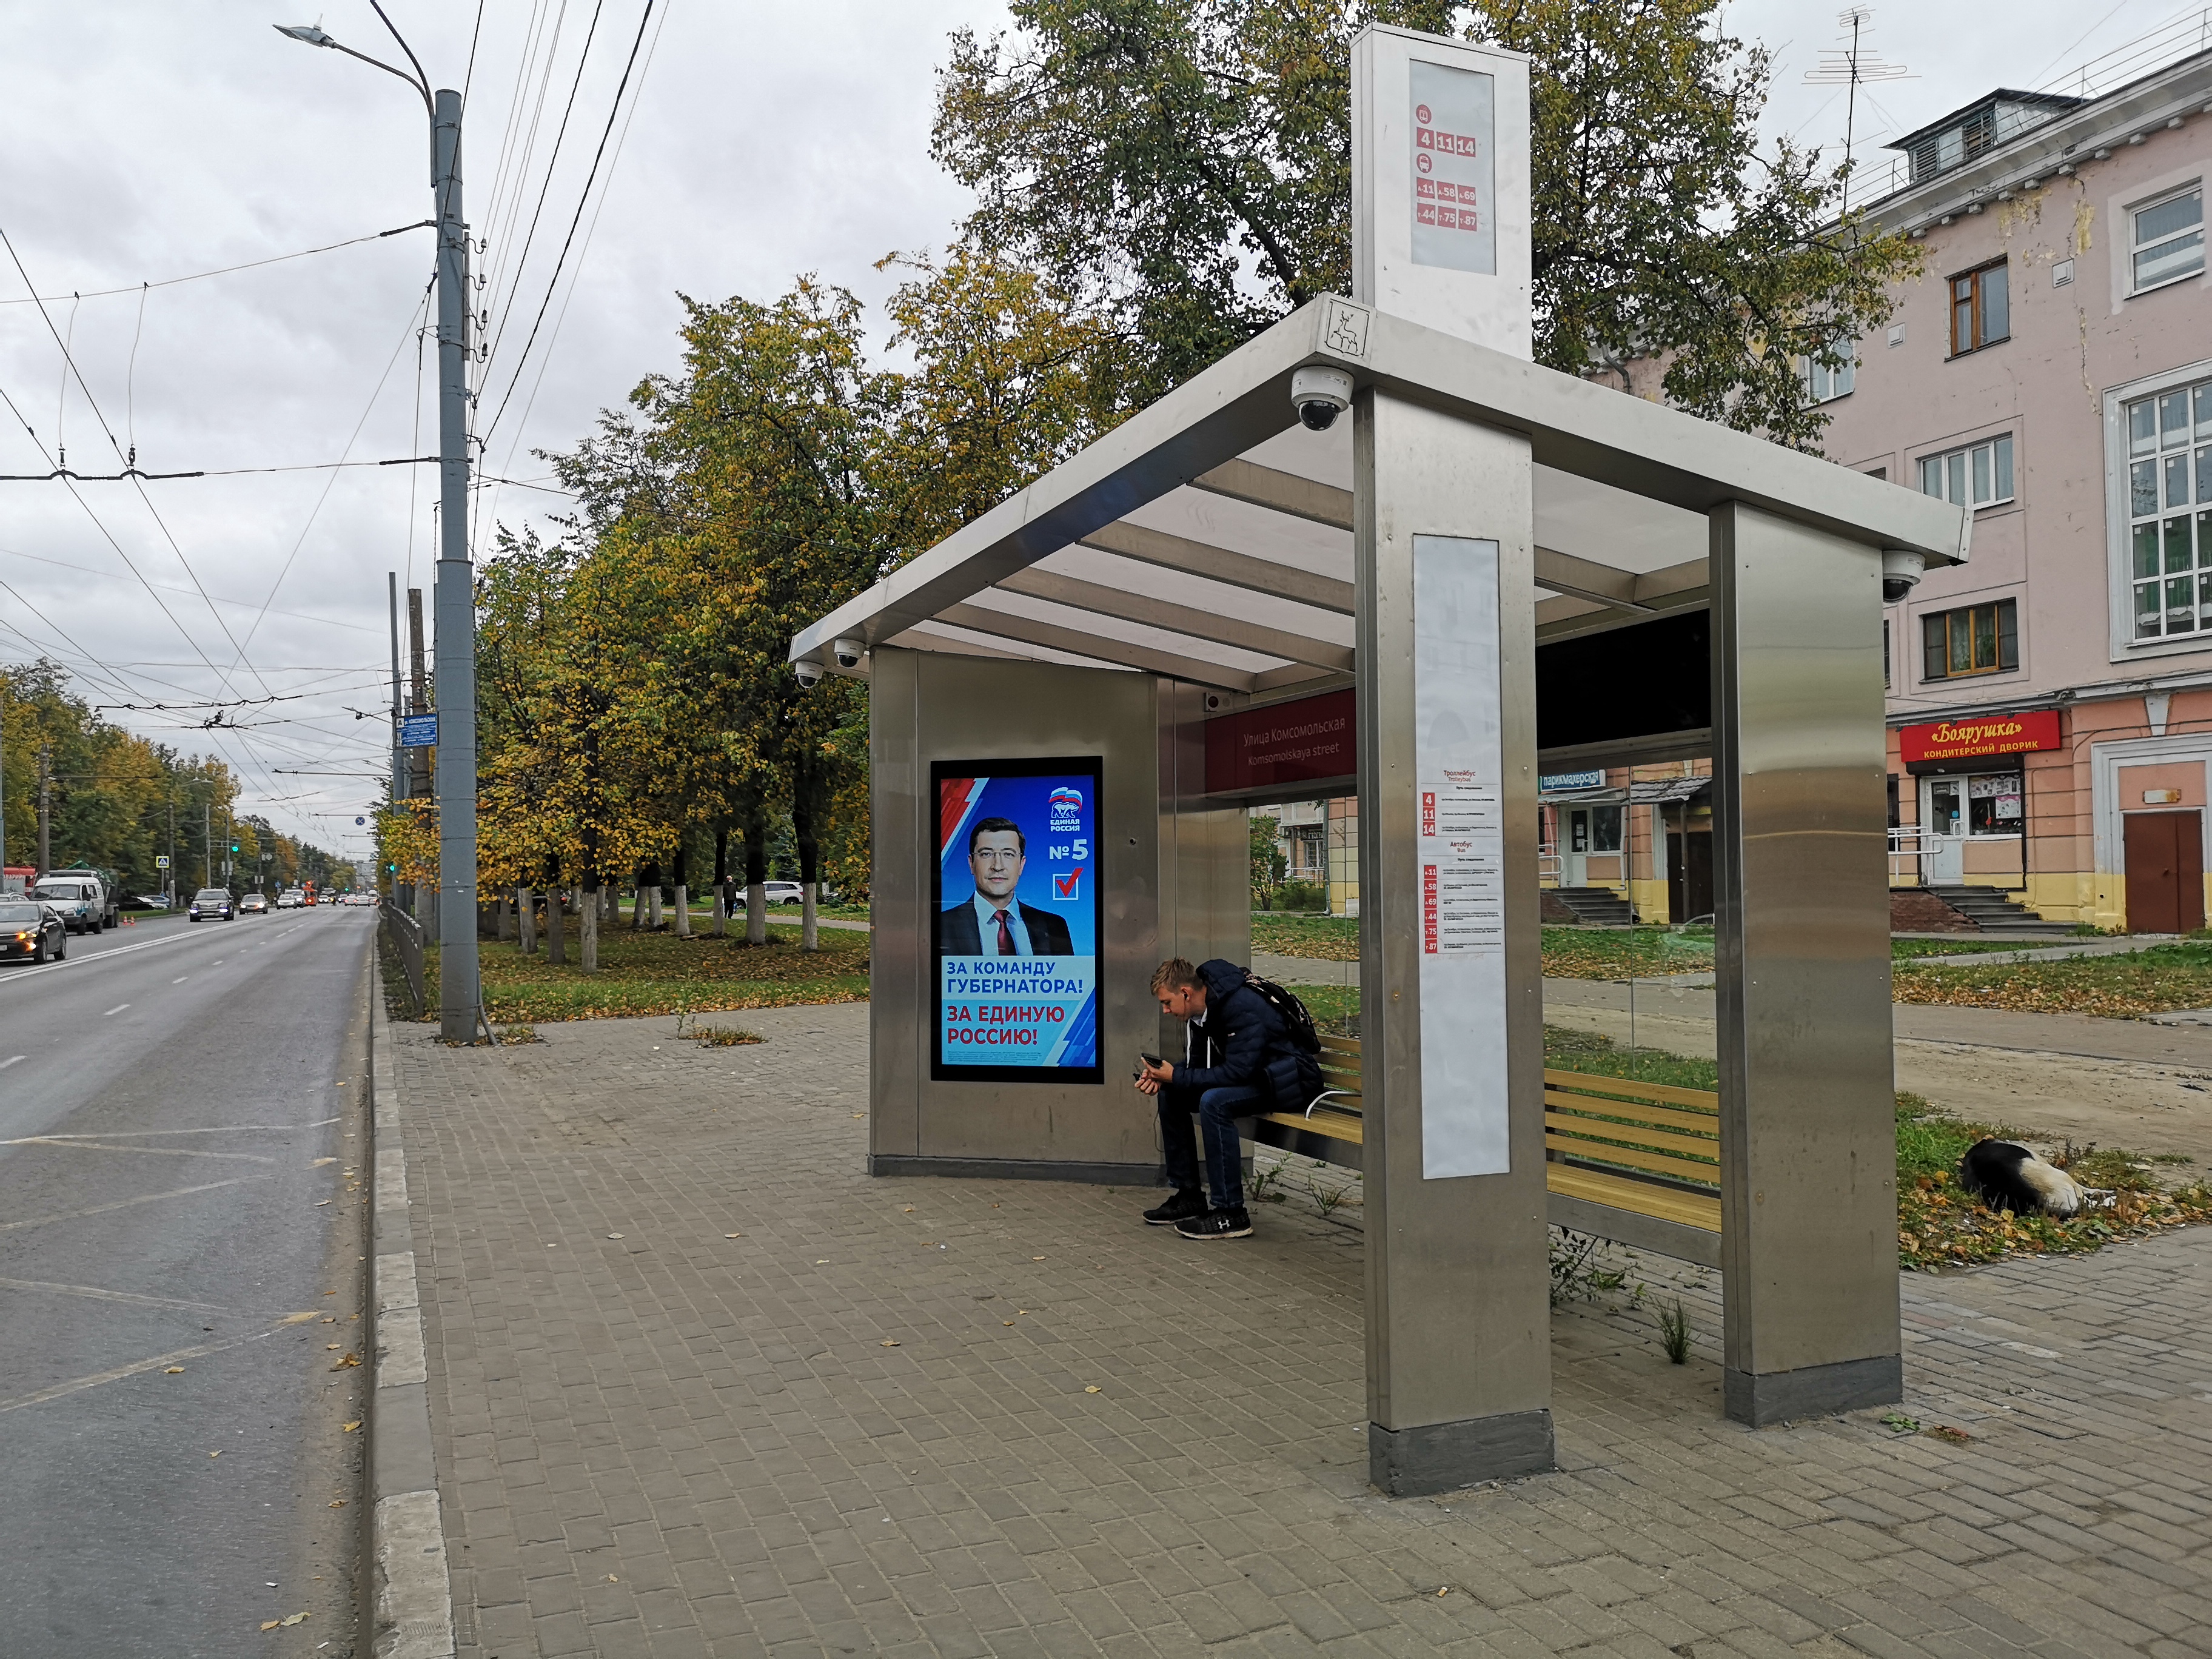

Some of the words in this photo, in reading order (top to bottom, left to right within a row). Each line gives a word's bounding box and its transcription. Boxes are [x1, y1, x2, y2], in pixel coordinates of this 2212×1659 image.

[1421, 132, 1430, 146] 4
[1438, 135, 1453, 151] 11
[1458, 139, 1475, 154] 14
[1244, 732, 1270, 747] Улица
[1272, 717, 1345, 742] Комсомольская
[1931, 722, 2022, 745] «Боярушка»
[1248, 748, 1312, 766] Komsomolskaya
[1313, 742, 1340, 756] street
[1924, 743, 1995, 759] КОНДИТЕРСКИЙ
[2000, 740, 2038, 753] ДВОРИК
[1543, 771, 1598, 788] парикмахерская
[1426, 795, 1432, 805] 4
[1423, 809, 1435, 819] 11
[1423, 824, 1435, 834] 14
[947, 962, 968, 974] ЗА
[974, 962, 1056, 976] КОМАНДУ
[948, 979, 1083, 993] ГУБЕРНАТОРА!
[947, 1005, 972, 1022] ЗА
[979, 1006, 1065, 1025] ЕДИНУЮ
[948, 1028, 1037, 1045] РОССИЮ!
